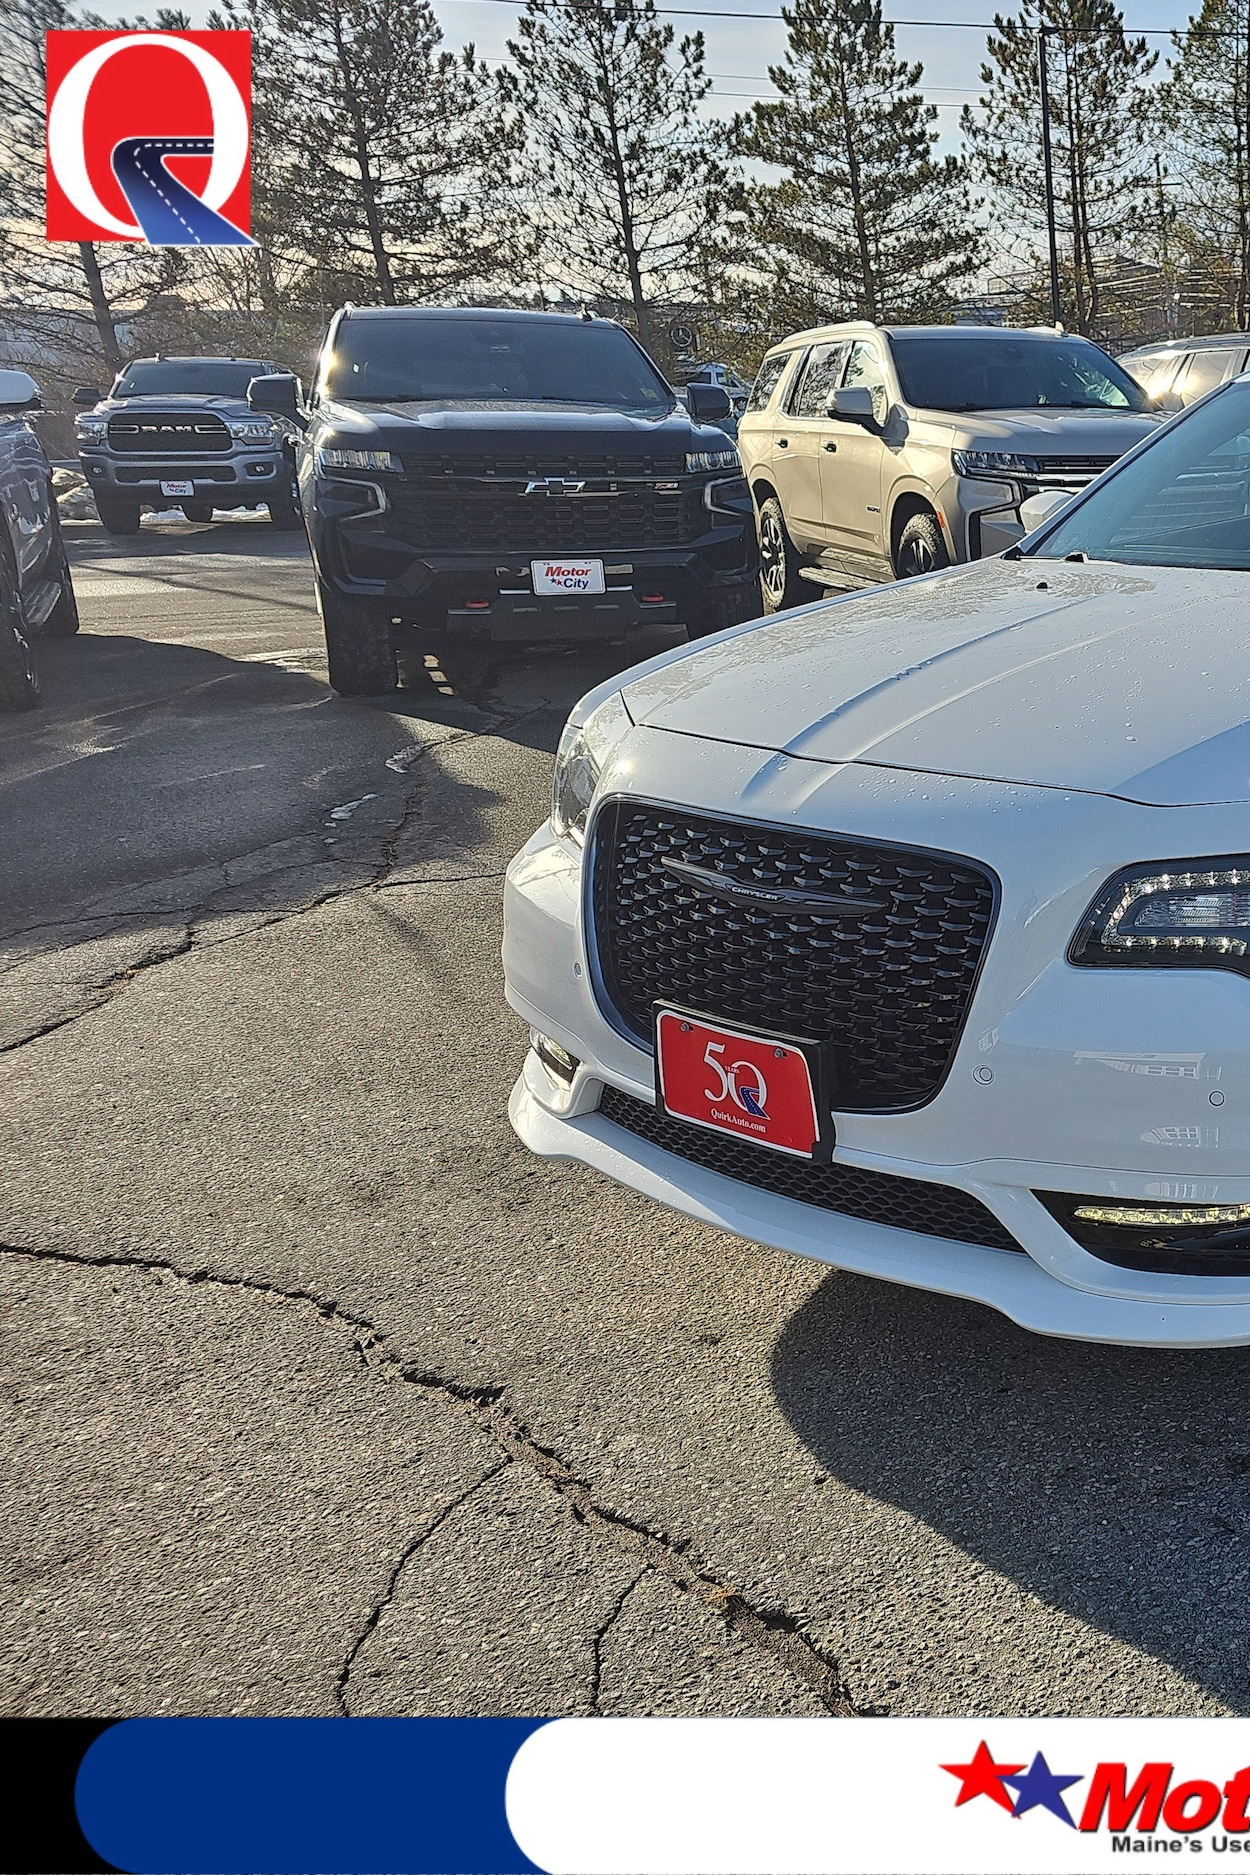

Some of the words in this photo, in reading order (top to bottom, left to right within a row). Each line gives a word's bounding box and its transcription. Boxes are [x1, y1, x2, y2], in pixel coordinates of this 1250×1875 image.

[141, 425, 192, 433] RAM
[545, 566, 592, 577] Motor
[563, 578, 590, 590] City
[731, 886, 778, 901] CHRYSLER
[710, 1108, 767, 1133] QuirkAuto.com
